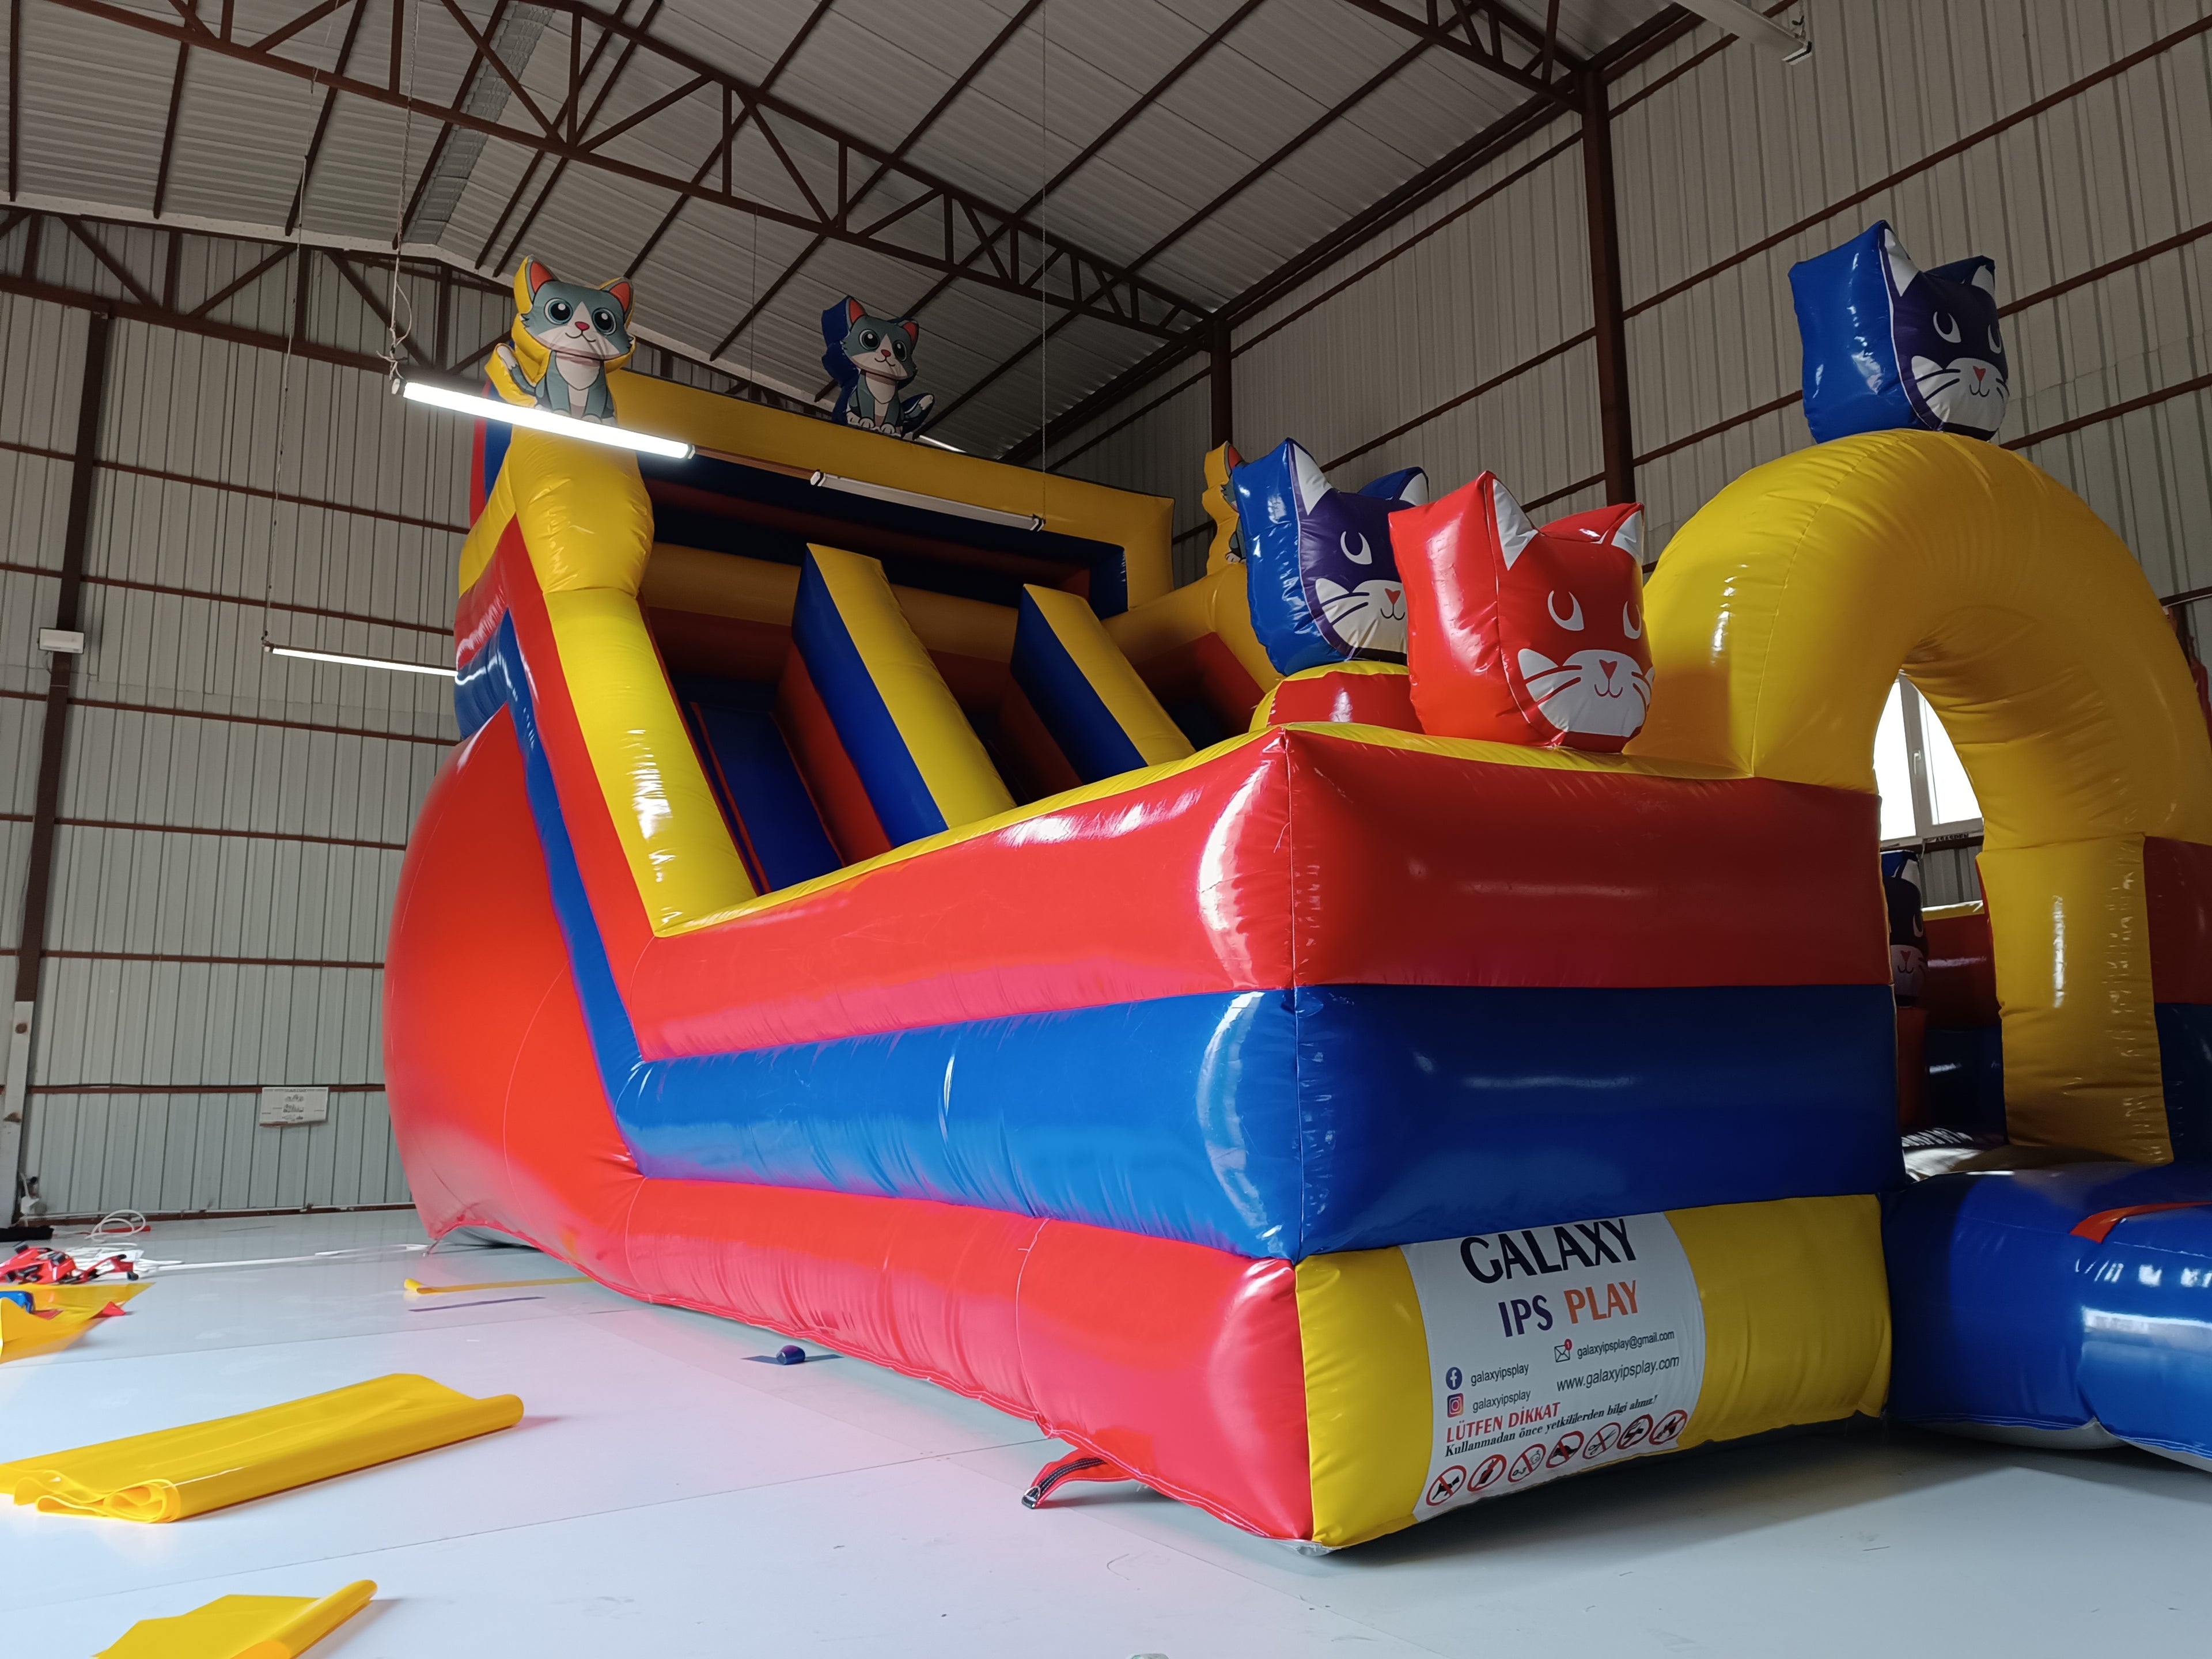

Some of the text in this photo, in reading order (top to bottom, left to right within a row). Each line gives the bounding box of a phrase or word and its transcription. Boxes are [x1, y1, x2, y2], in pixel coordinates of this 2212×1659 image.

[1460, 1218, 1637, 1283] GALAXY
[1498, 1280, 1638, 1338] IPS PLAY
[1577, 1331, 1675, 1359] galaxyipsplay@gmail.com
[1471, 1363, 1529, 1387] galaxyipsplay
[1556, 1356, 1680, 1392] www.galaxyipsplay.com
[1472, 1389, 1531, 1414] galaxyipsplay
[1445, 1431, 1516, 1457] Kullanmadan
[1519, 1426, 1543, 1438] önce
[1544, 1408, 1604, 1434] yetkililerden
[1607, 1402, 1628, 1415] bilgi
[1446, 1402, 1561, 1443] LÜTFEN DİKKAT
